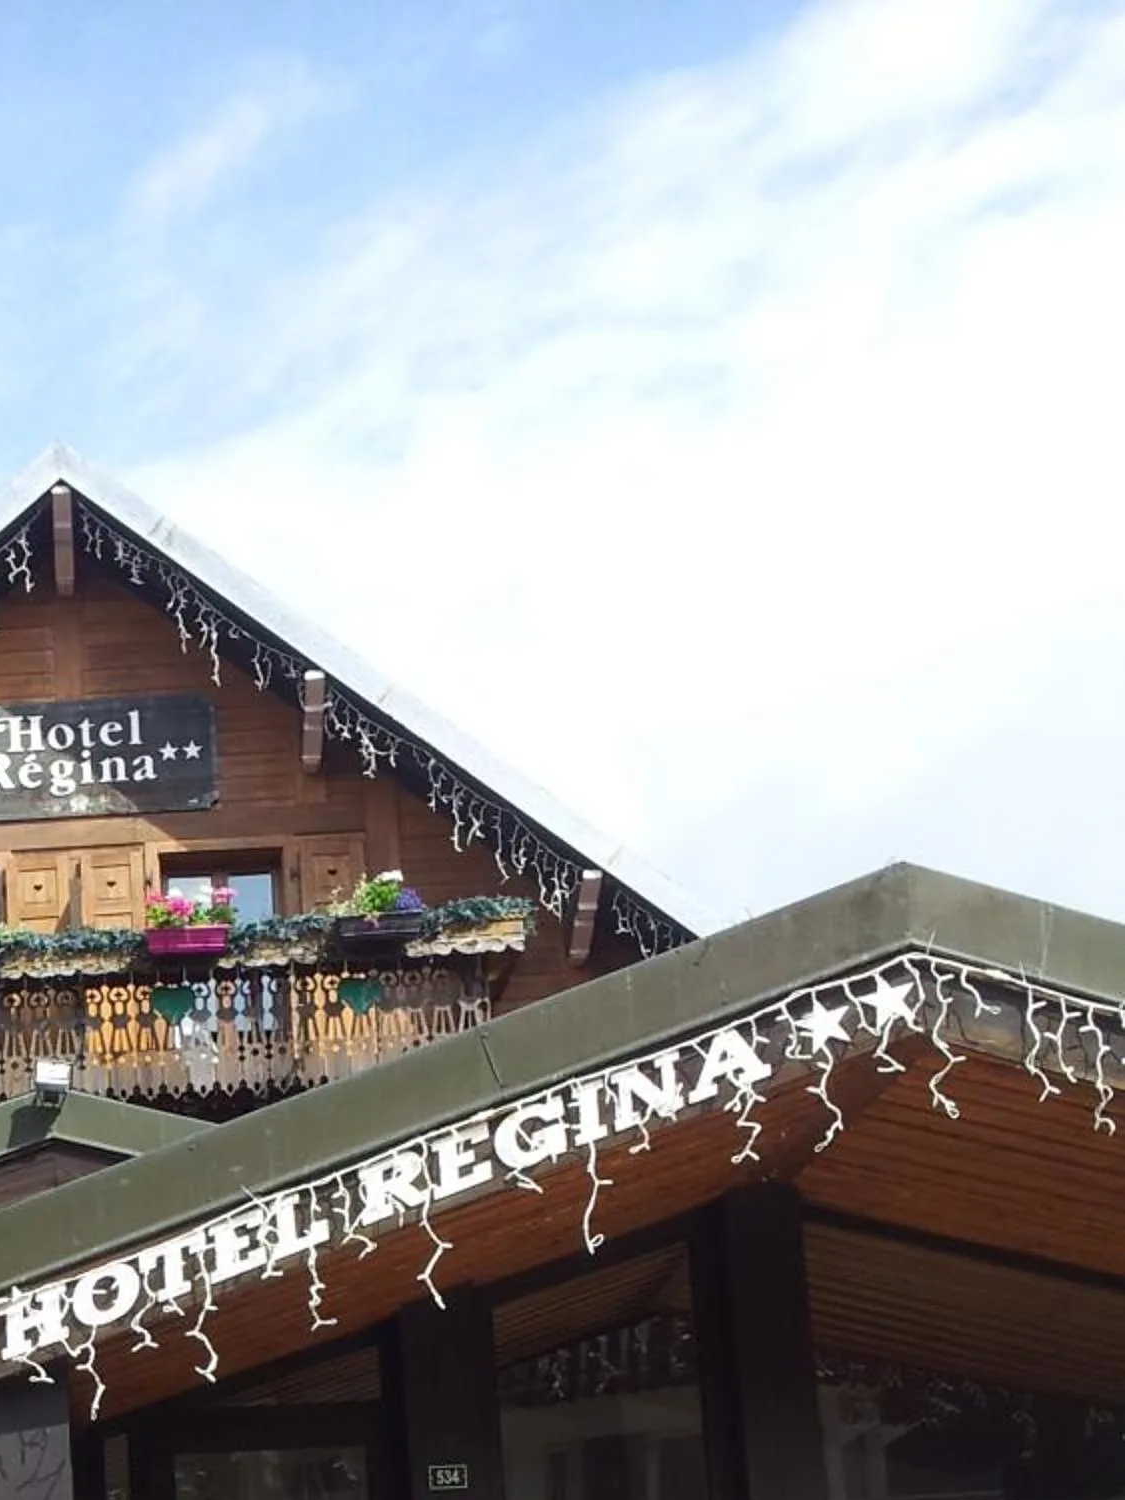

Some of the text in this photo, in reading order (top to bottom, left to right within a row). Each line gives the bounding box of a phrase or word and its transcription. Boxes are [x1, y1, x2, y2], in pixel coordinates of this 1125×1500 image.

[0, 1028, 772, 1361] HOTEL REGINA
[436, 1469, 460, 1485] 534
